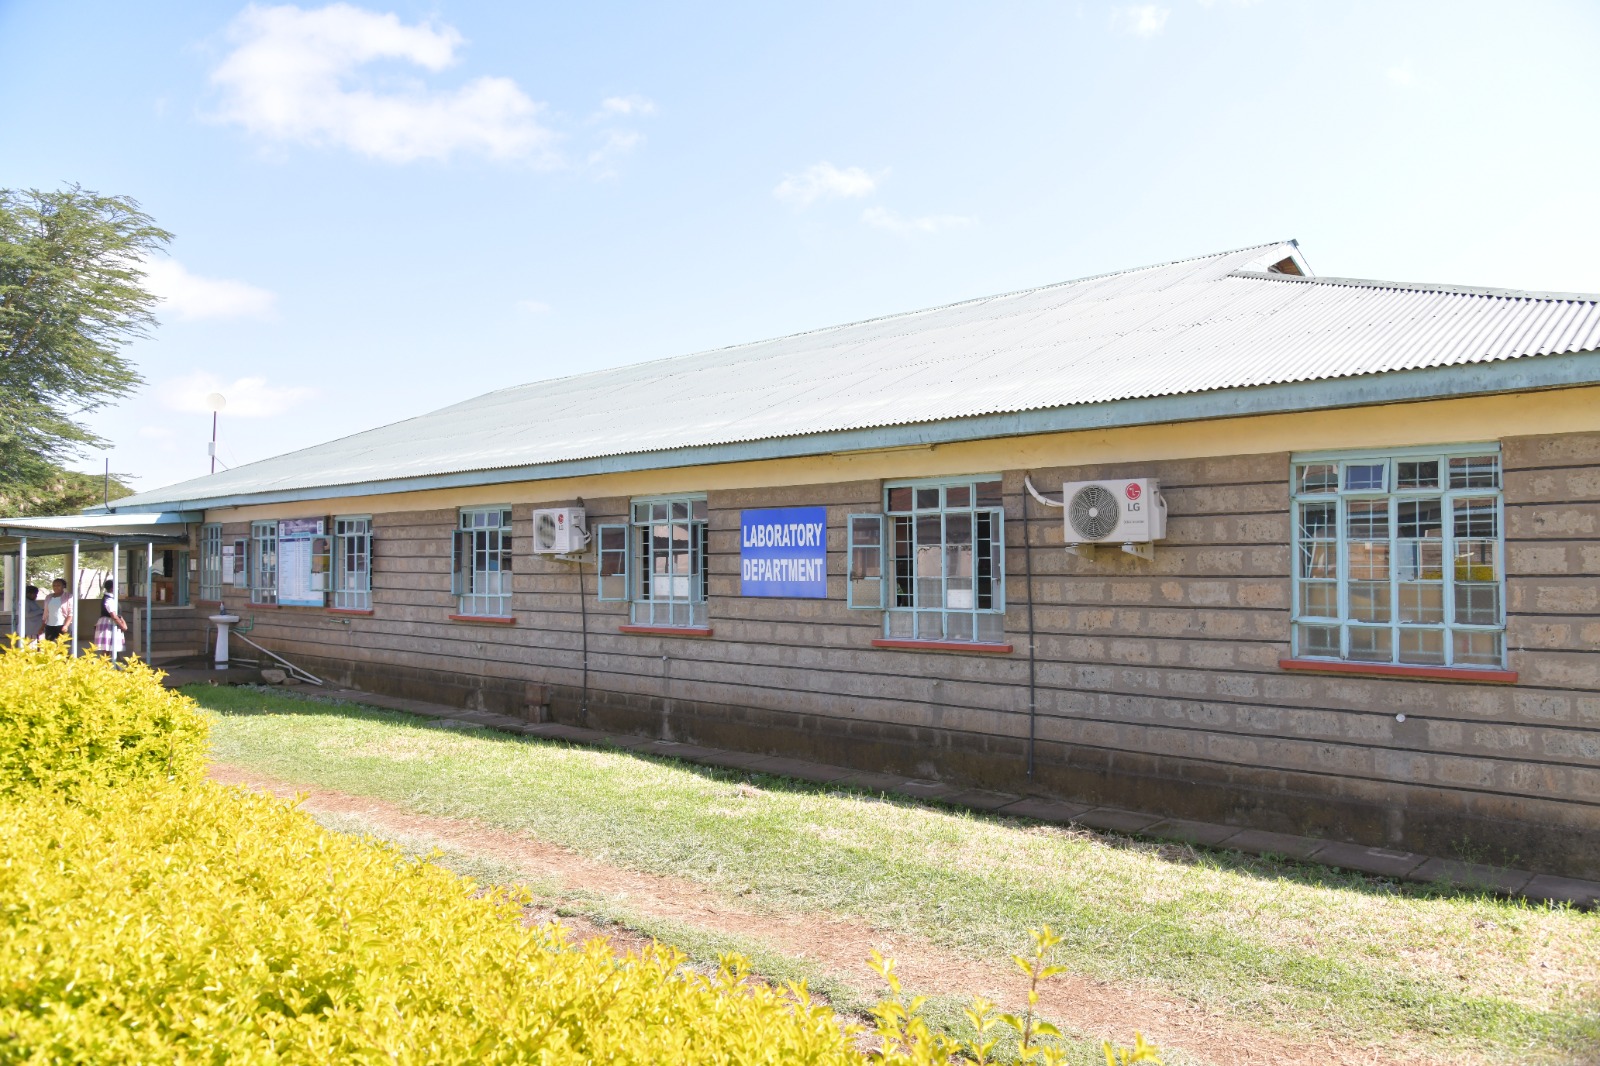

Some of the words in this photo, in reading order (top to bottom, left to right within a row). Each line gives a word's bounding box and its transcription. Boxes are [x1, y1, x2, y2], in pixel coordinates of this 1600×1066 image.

[1127, 502, 1141, 512] LG
[743, 523, 823, 548] LABORATORY
[743, 558, 823, 582] DEPARTMENT
